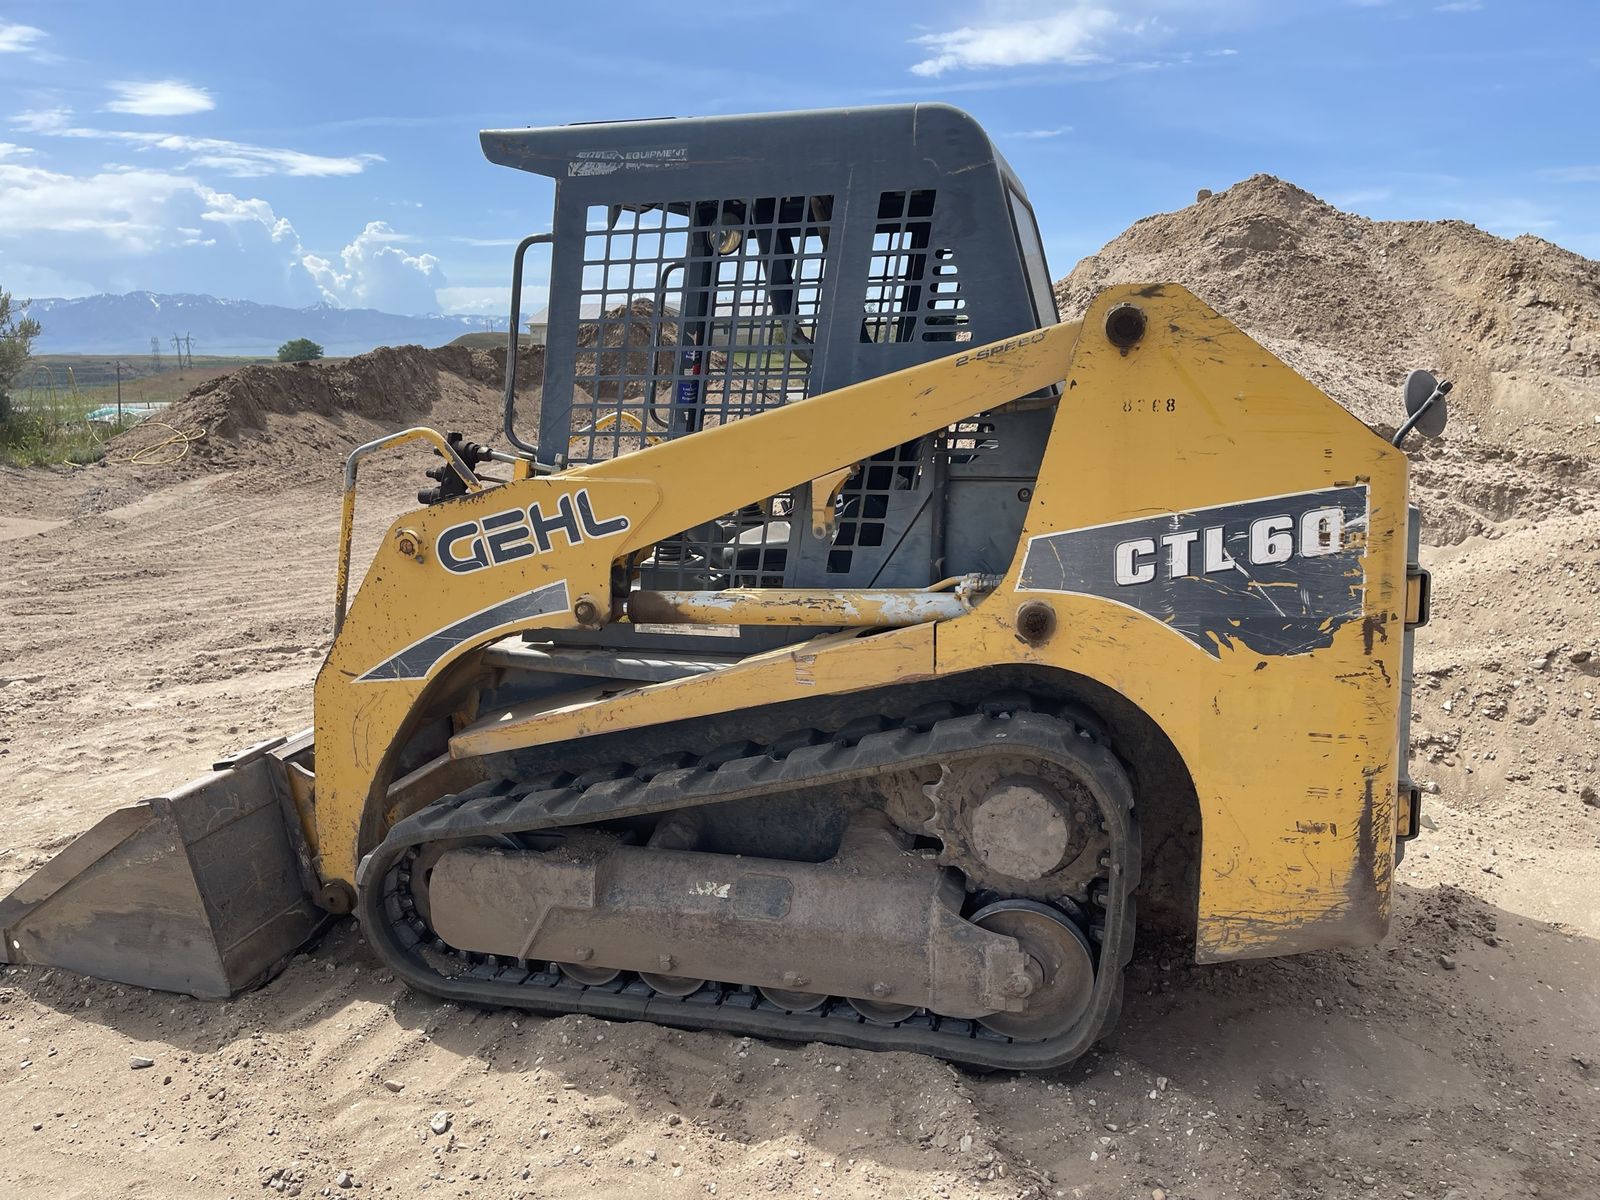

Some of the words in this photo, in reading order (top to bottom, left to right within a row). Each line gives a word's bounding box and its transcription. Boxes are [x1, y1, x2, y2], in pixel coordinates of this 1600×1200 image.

[435, 488, 631, 575] GEHL
[1113, 528, 1237, 587] CTL
[1249, 506, 1346, 566] 60
